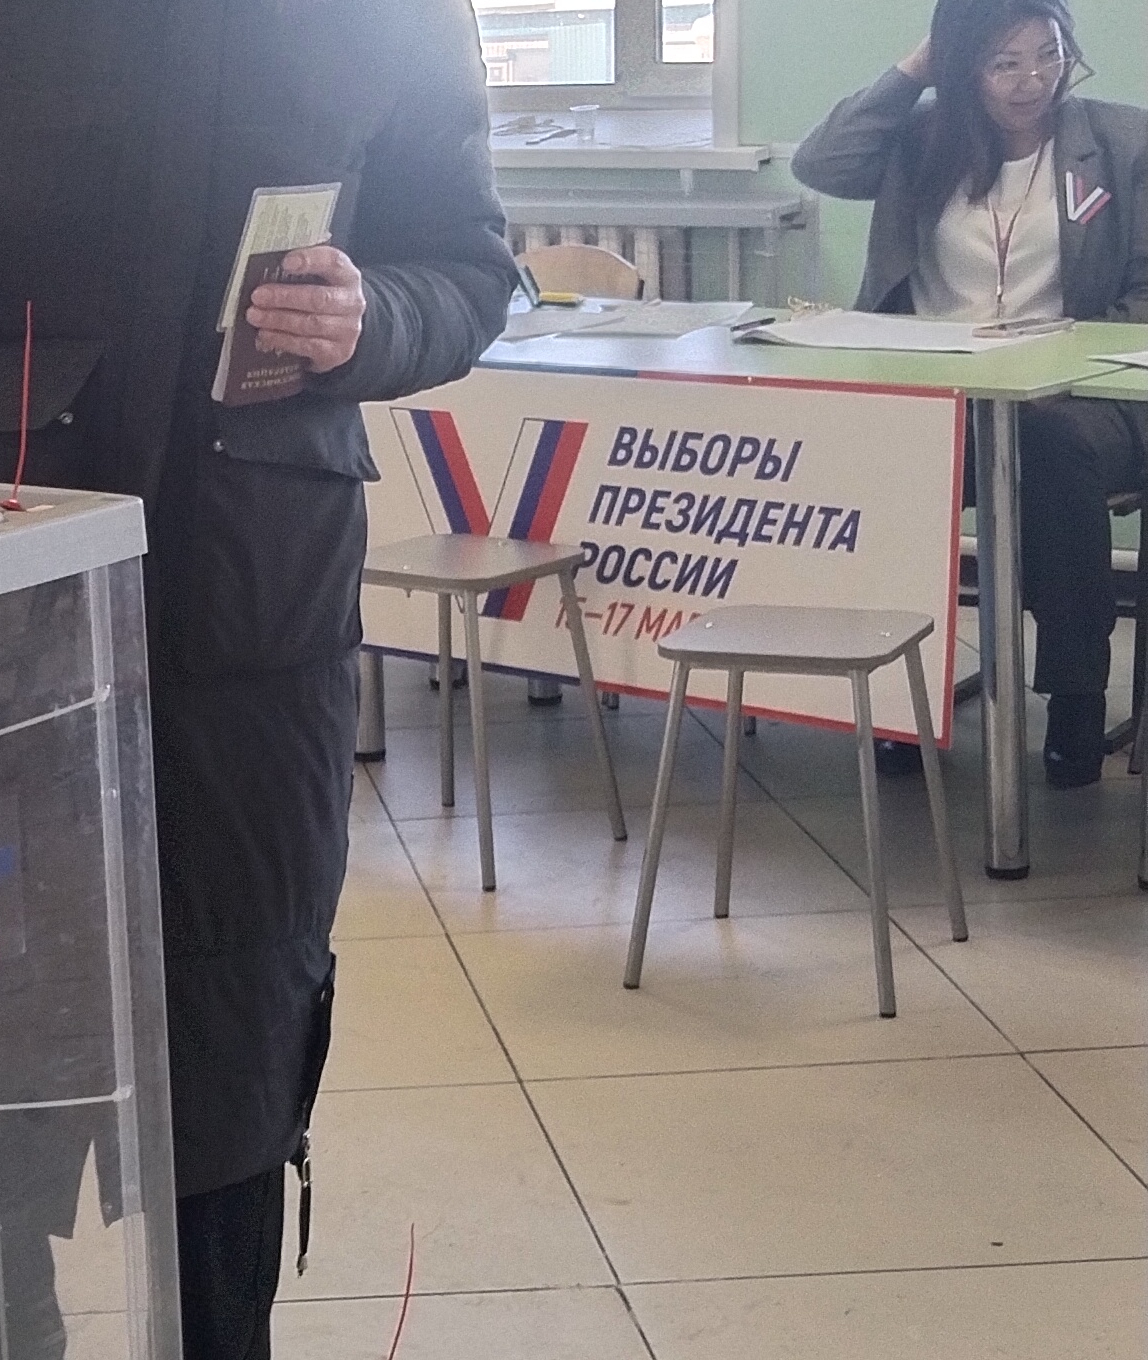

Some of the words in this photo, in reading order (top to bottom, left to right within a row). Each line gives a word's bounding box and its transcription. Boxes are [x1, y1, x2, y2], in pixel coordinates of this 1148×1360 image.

[607, 426, 803, 482] ВЫБОРЫ
[587, 484, 861, 553] ПРЕЗИДЕНТА
[572, 540, 740, 600] РОССИИ
[555, 596, 635, 637] 1–17
